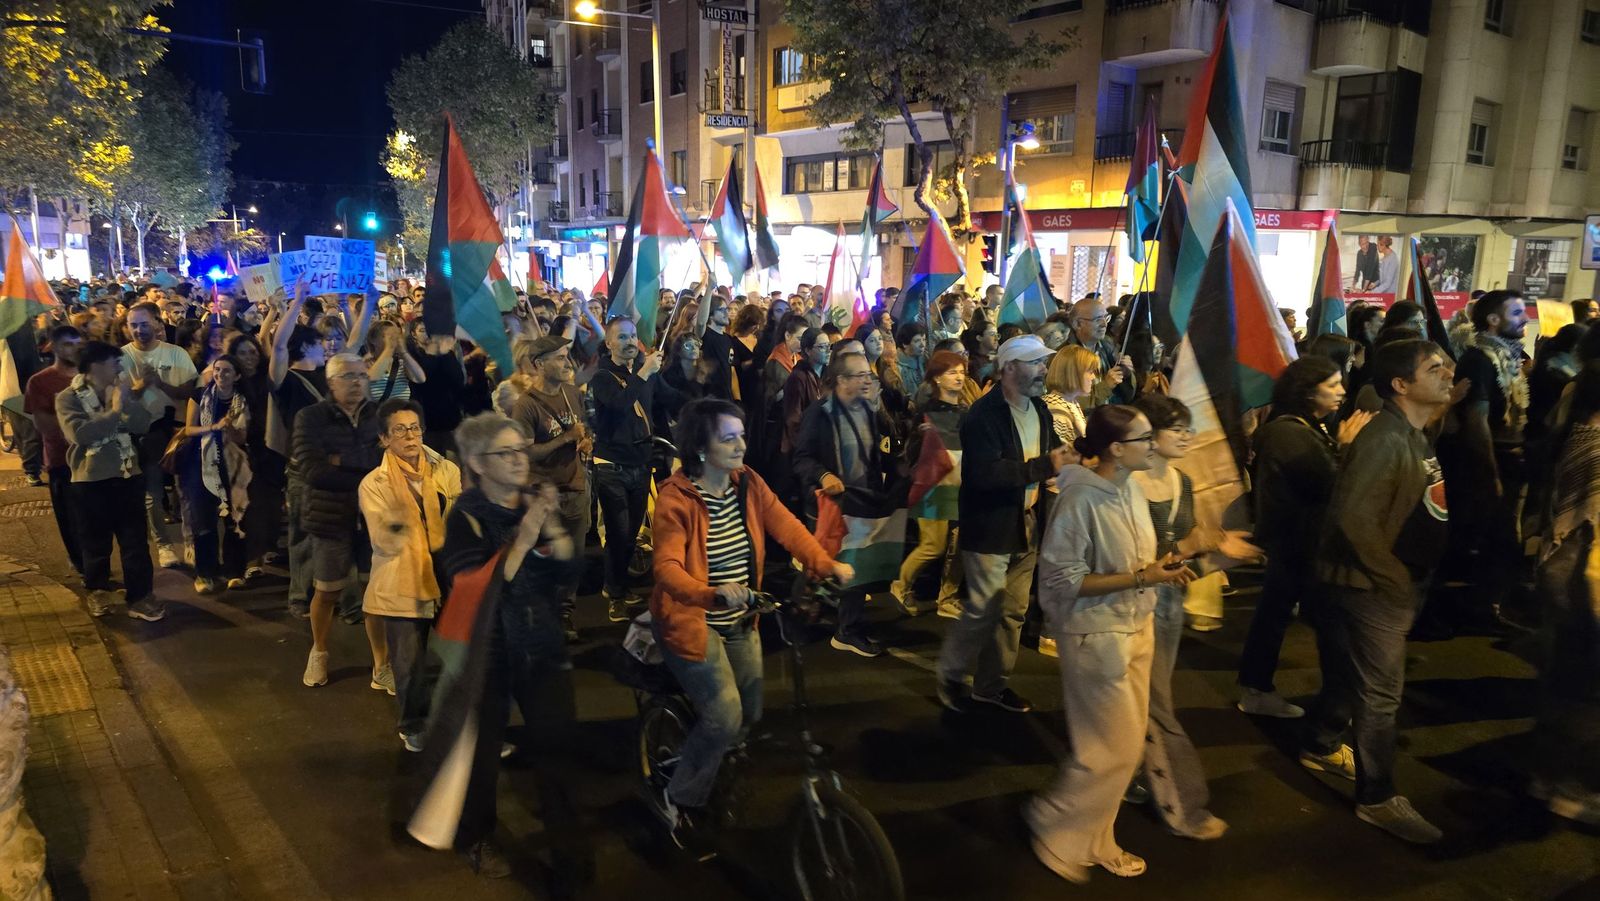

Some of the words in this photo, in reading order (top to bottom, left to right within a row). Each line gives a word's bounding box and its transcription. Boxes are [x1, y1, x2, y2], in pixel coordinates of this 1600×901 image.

[706, 7, 744, 21] HOSTAL
[723, 23, 732, 112] INTERNACIONAL
[707, 114, 748, 127] RESIDENCIA
[1042, 214, 1072, 227] GAES
[1254, 213, 1280, 227] GAES
[308, 253, 338, 271] GAZA
[309, 272, 373, 290] AMENAZA
